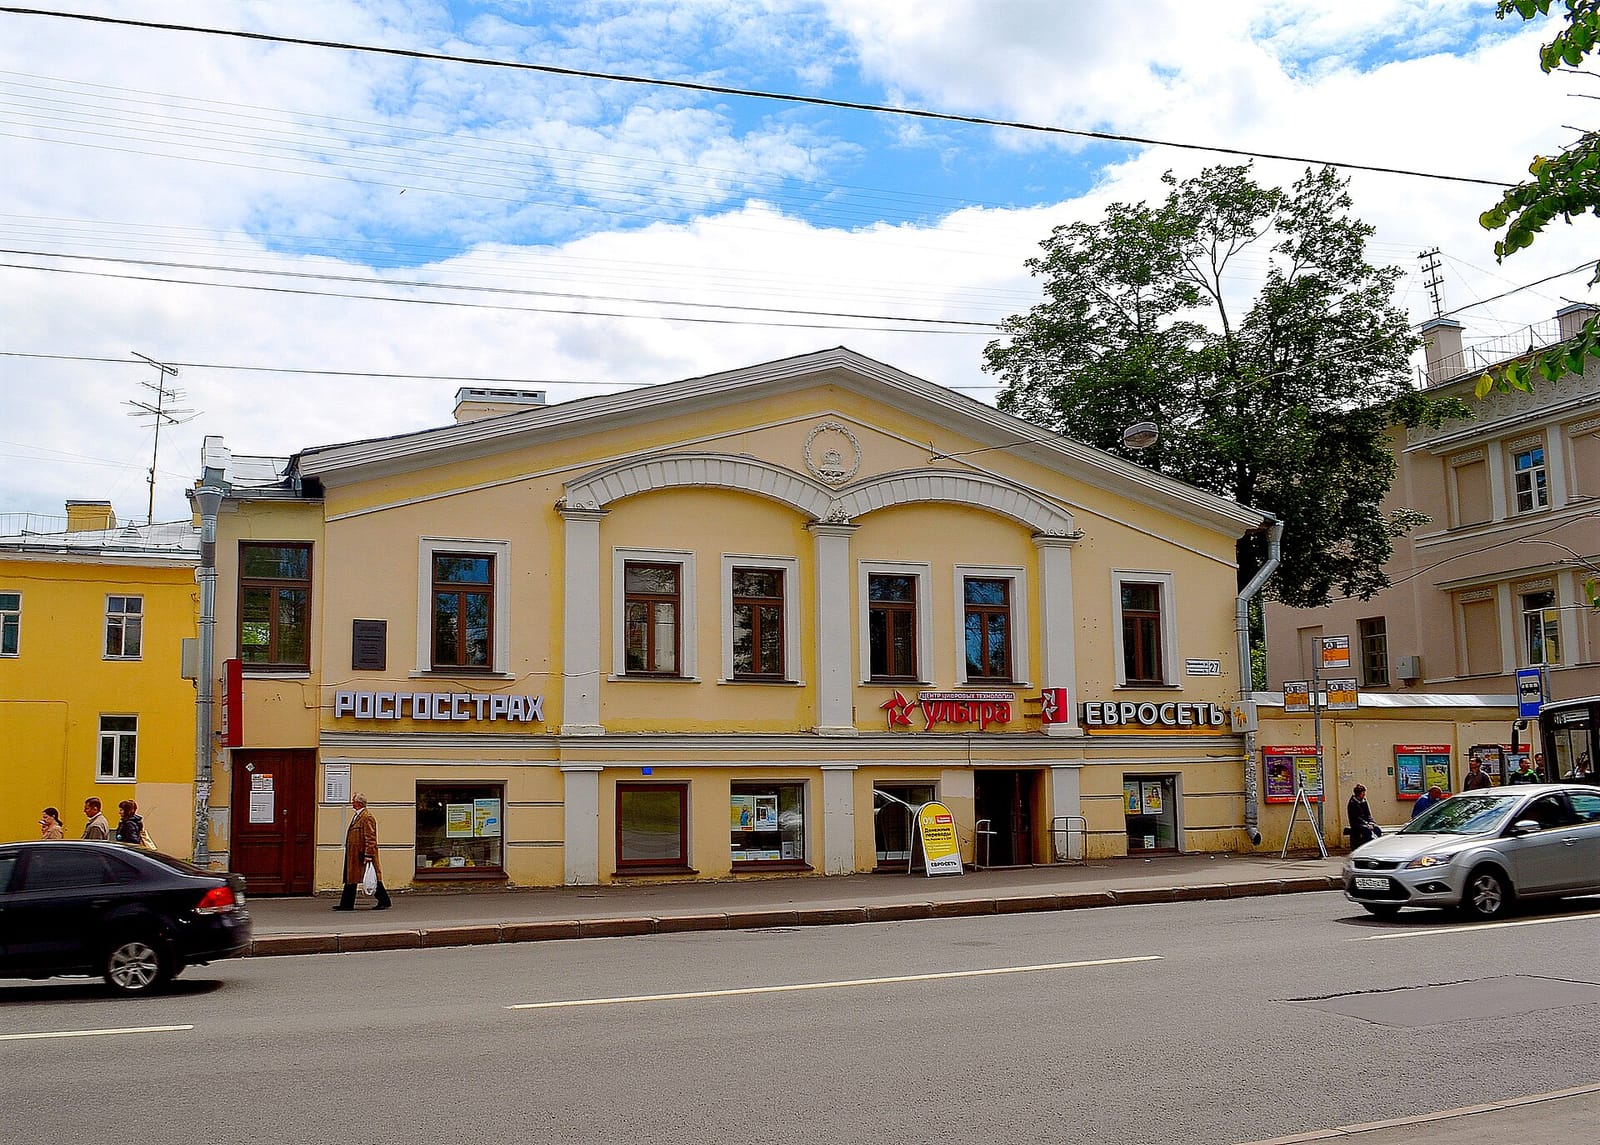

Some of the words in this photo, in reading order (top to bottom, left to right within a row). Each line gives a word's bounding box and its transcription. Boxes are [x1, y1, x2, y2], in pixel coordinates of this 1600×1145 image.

[1210, 663, 1218, 672] 27
[335, 690, 545, 721] РОСГОССТРАХ
[1085, 701, 1225, 726] ЕВРОСЕТЬ
